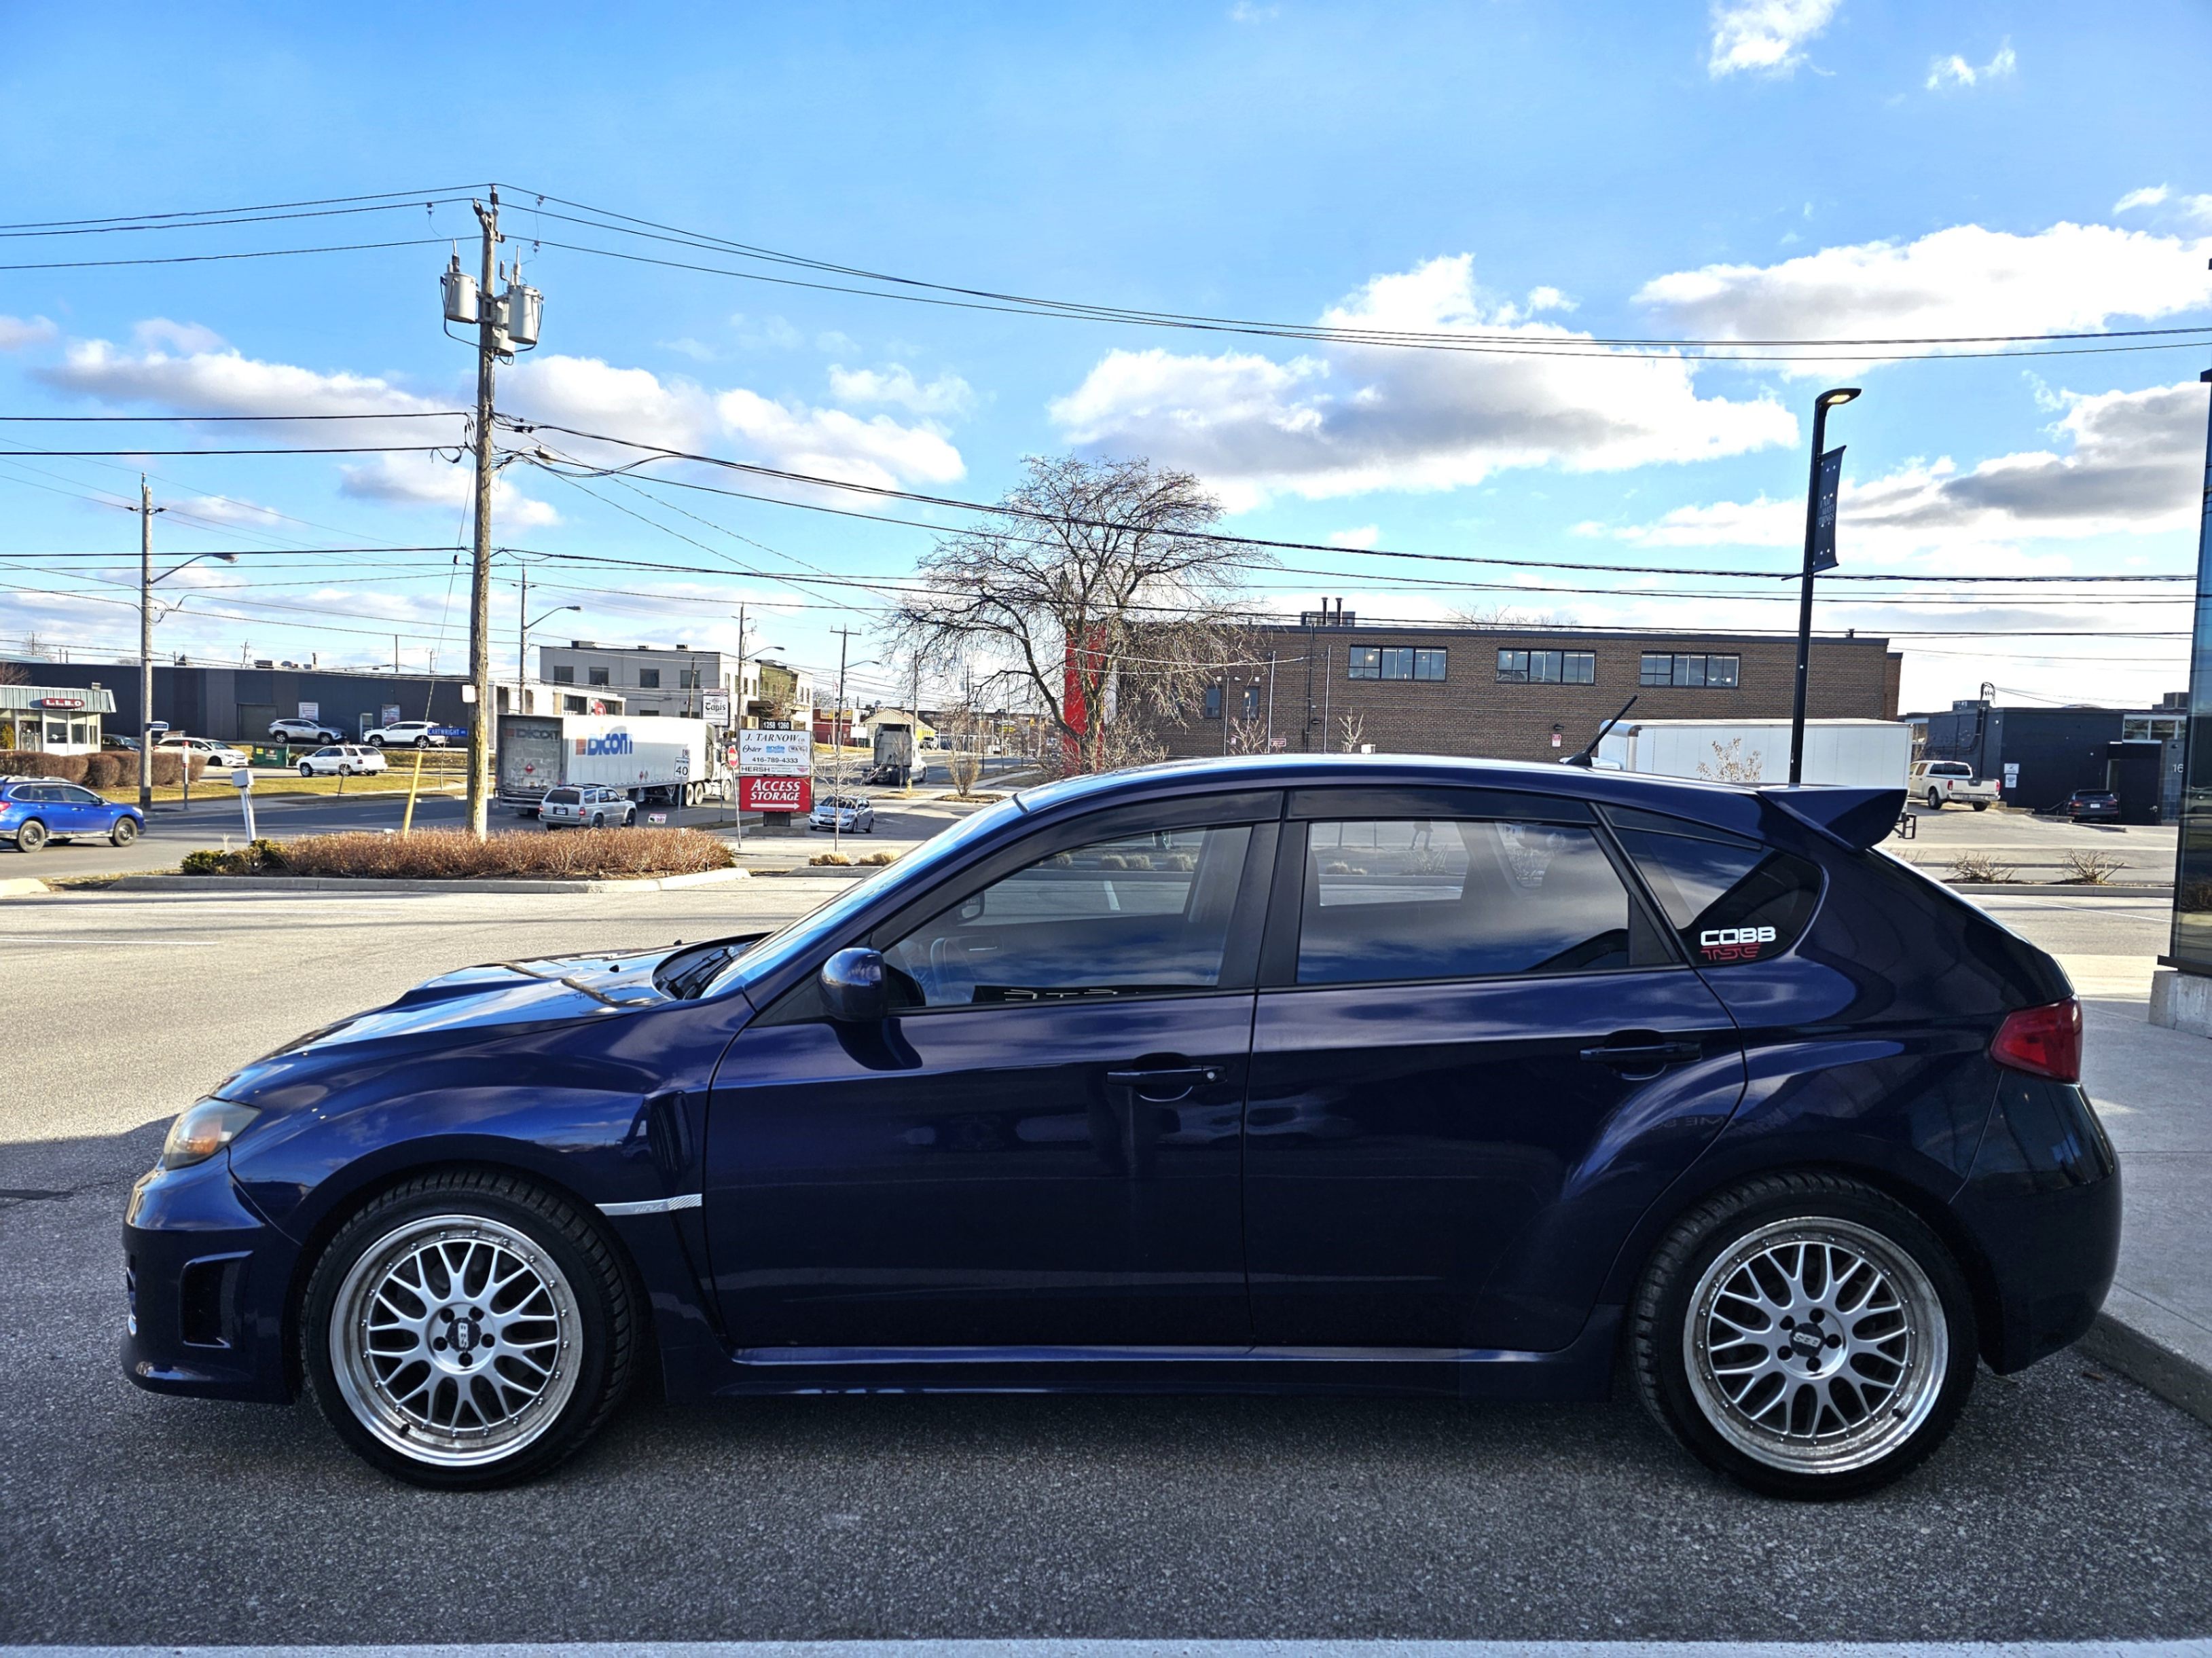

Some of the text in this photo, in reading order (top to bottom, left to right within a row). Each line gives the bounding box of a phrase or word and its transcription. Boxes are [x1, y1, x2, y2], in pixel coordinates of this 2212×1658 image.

[763, 721, 776, 729] 1258
[745, 733, 753, 741] J.
[756, 733, 799, 742] TARNOW
[742, 745, 762, 753] Oster
[675, 767, 689, 776] 40
[750, 779, 801, 792] ACCESS
[750, 792, 801, 800] STORAGE
[1700, 926, 1777, 946] COBB
